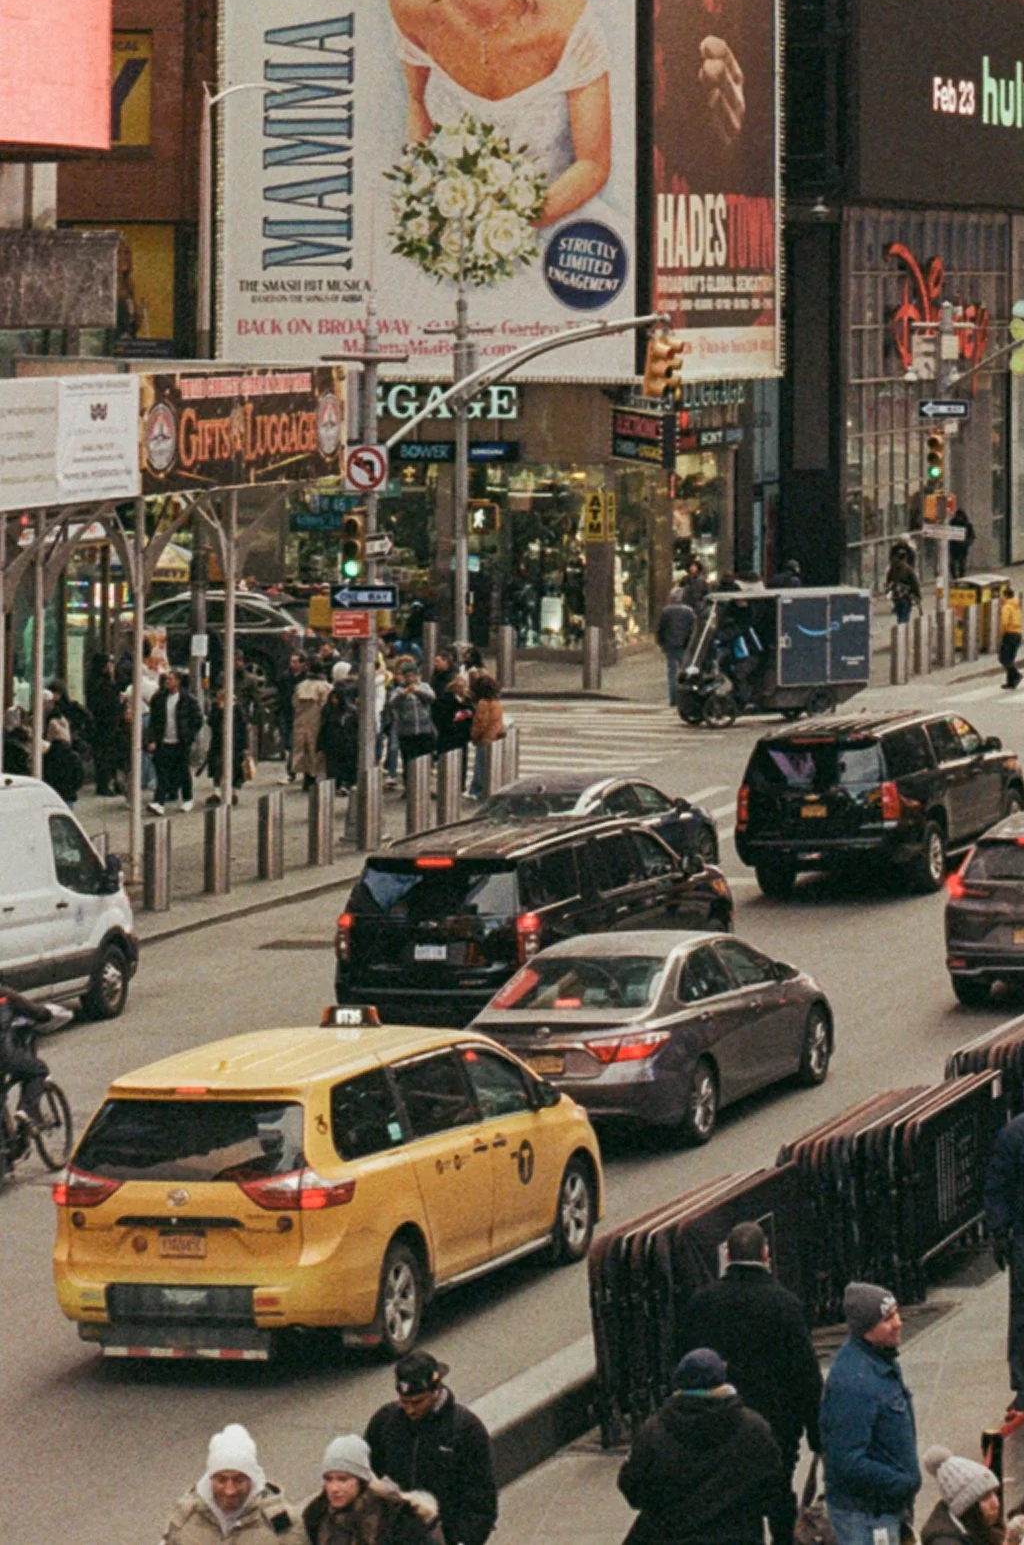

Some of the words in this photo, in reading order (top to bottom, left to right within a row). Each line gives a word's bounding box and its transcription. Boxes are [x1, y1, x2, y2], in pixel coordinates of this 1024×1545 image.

[933, 76, 957, 113] Feb
[959, 79, 975, 115] 23
[262, 12, 355, 271] MAMMA
[558, 237, 618, 259] STRICTLY
[559, 253, 613, 275] LIMITED
[239, 279, 259, 292] THE
[262, 279, 301, 292] SMASH
[548, 265, 620, 291] ENGAGEMENT
[237, 318, 283, 336] BACK
[288, 318, 311, 336] ON
[179, 408, 231, 467] GIFTS
[244, 404, 317, 461] LUGGAGE
[588, 495, 602, 534] ATM
